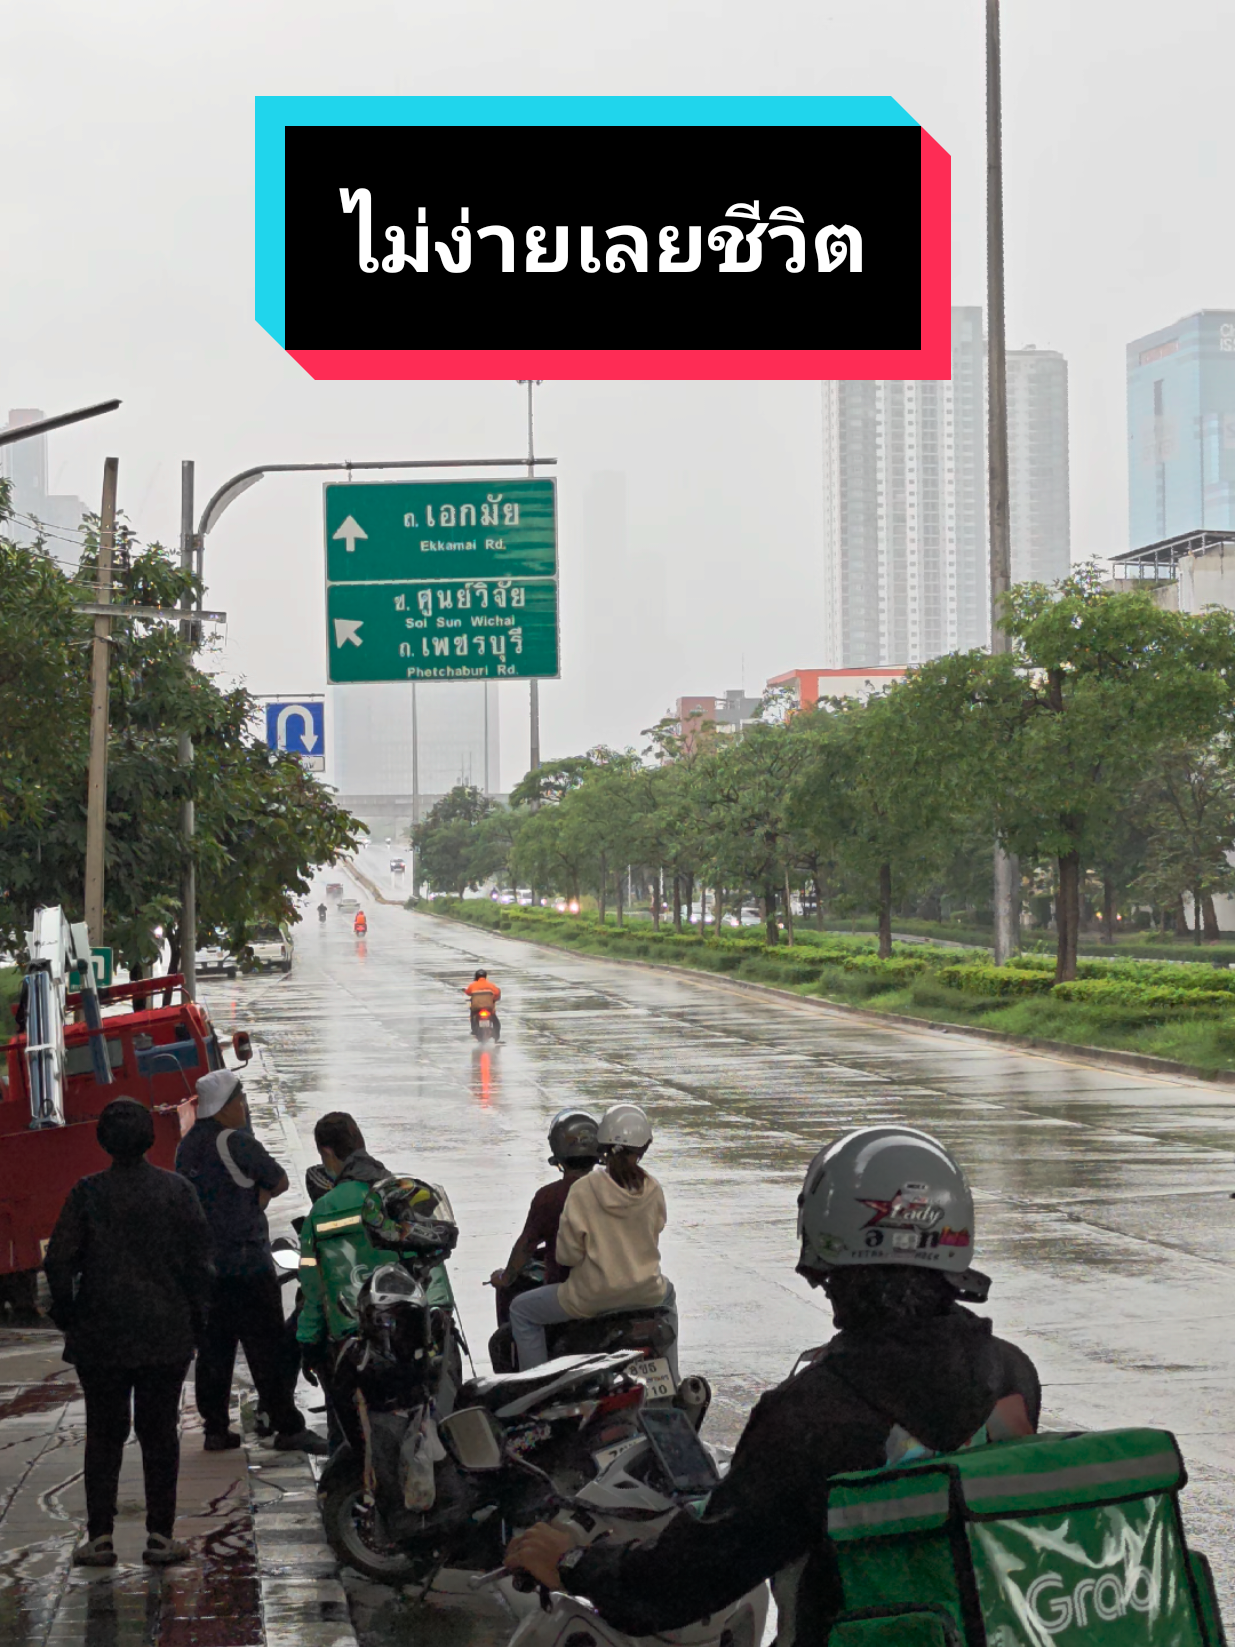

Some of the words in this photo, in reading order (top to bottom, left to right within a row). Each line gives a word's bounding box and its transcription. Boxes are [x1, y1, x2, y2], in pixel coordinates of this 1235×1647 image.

[420, 540, 477, 552] Ekkamai
[485, 538, 507, 550] Rd.
[405, 617, 428, 629] Soi
[436, 616, 462, 628] Sun
[470, 615, 516, 627] Wichai
[407, 665, 489, 678] Phetchaburi
[497, 664, 519, 676] Rd.
